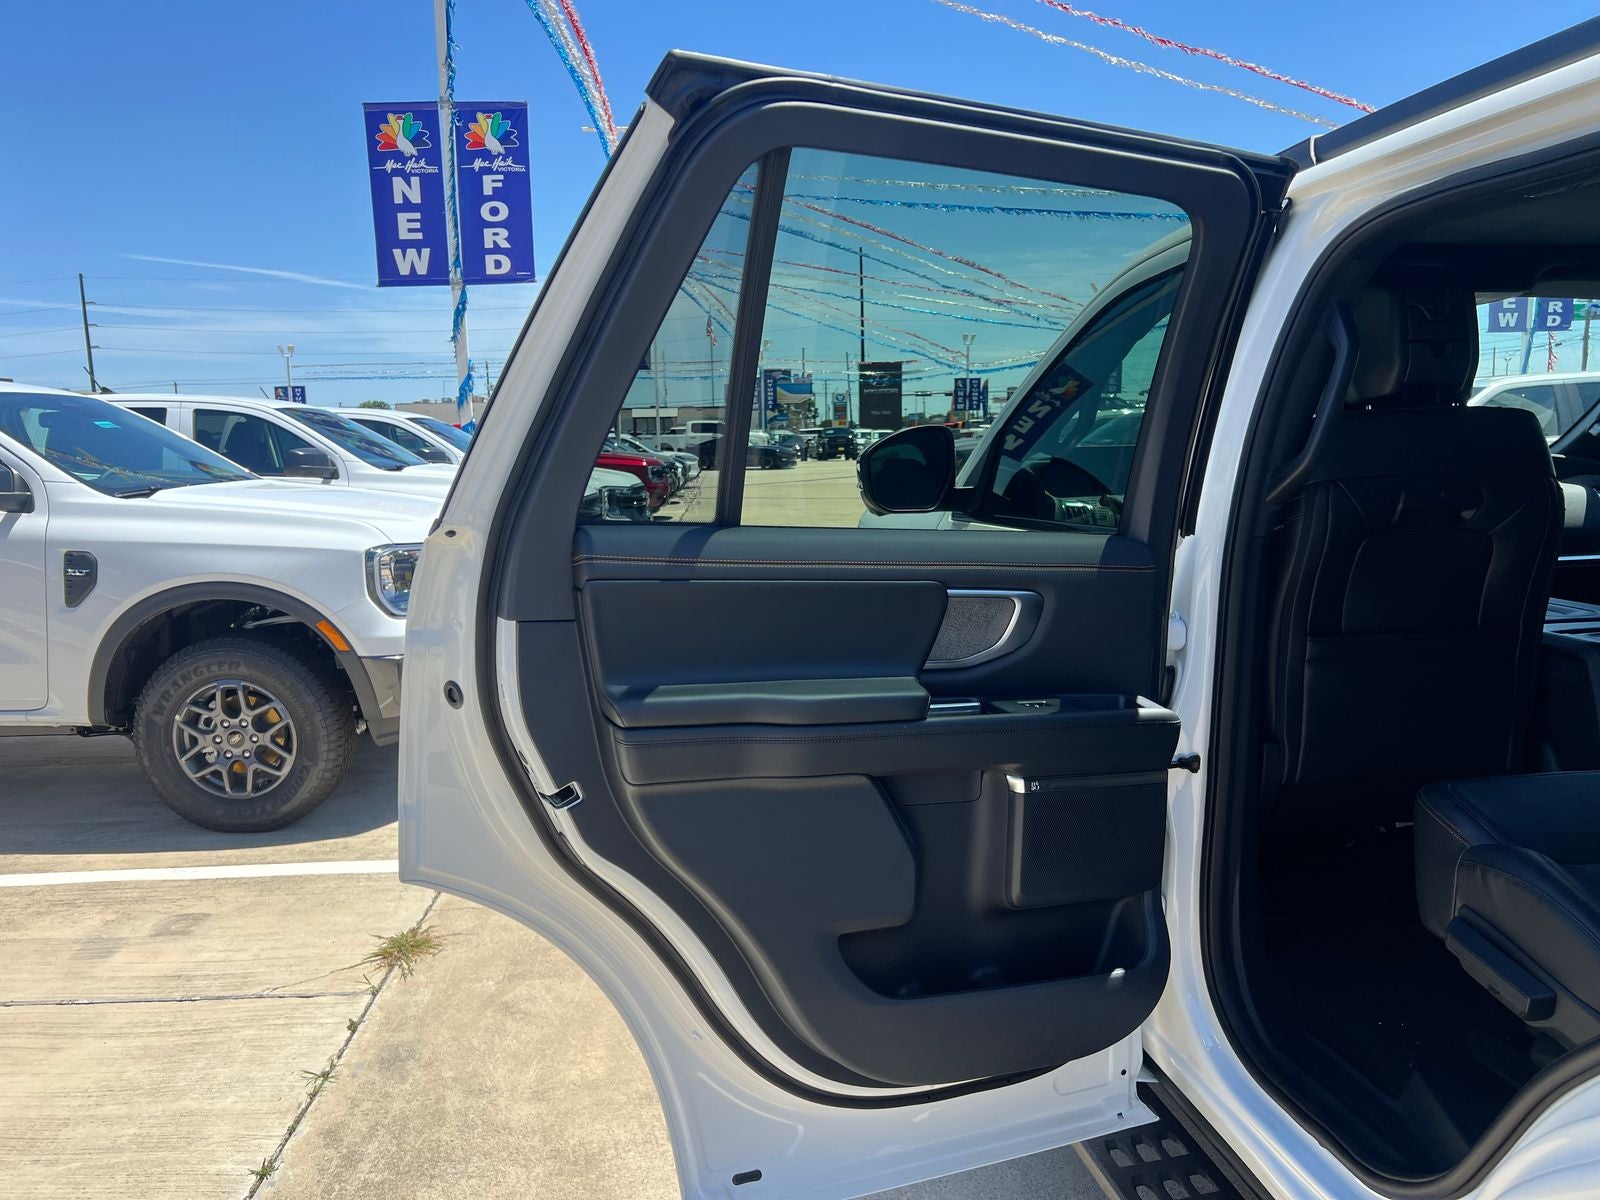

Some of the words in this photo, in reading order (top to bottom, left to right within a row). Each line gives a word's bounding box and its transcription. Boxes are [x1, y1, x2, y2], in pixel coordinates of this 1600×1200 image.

[392, 176, 430, 275] NEW
[480, 175, 511, 275] FORD
[153, 660, 241, 717] WRANGLER
